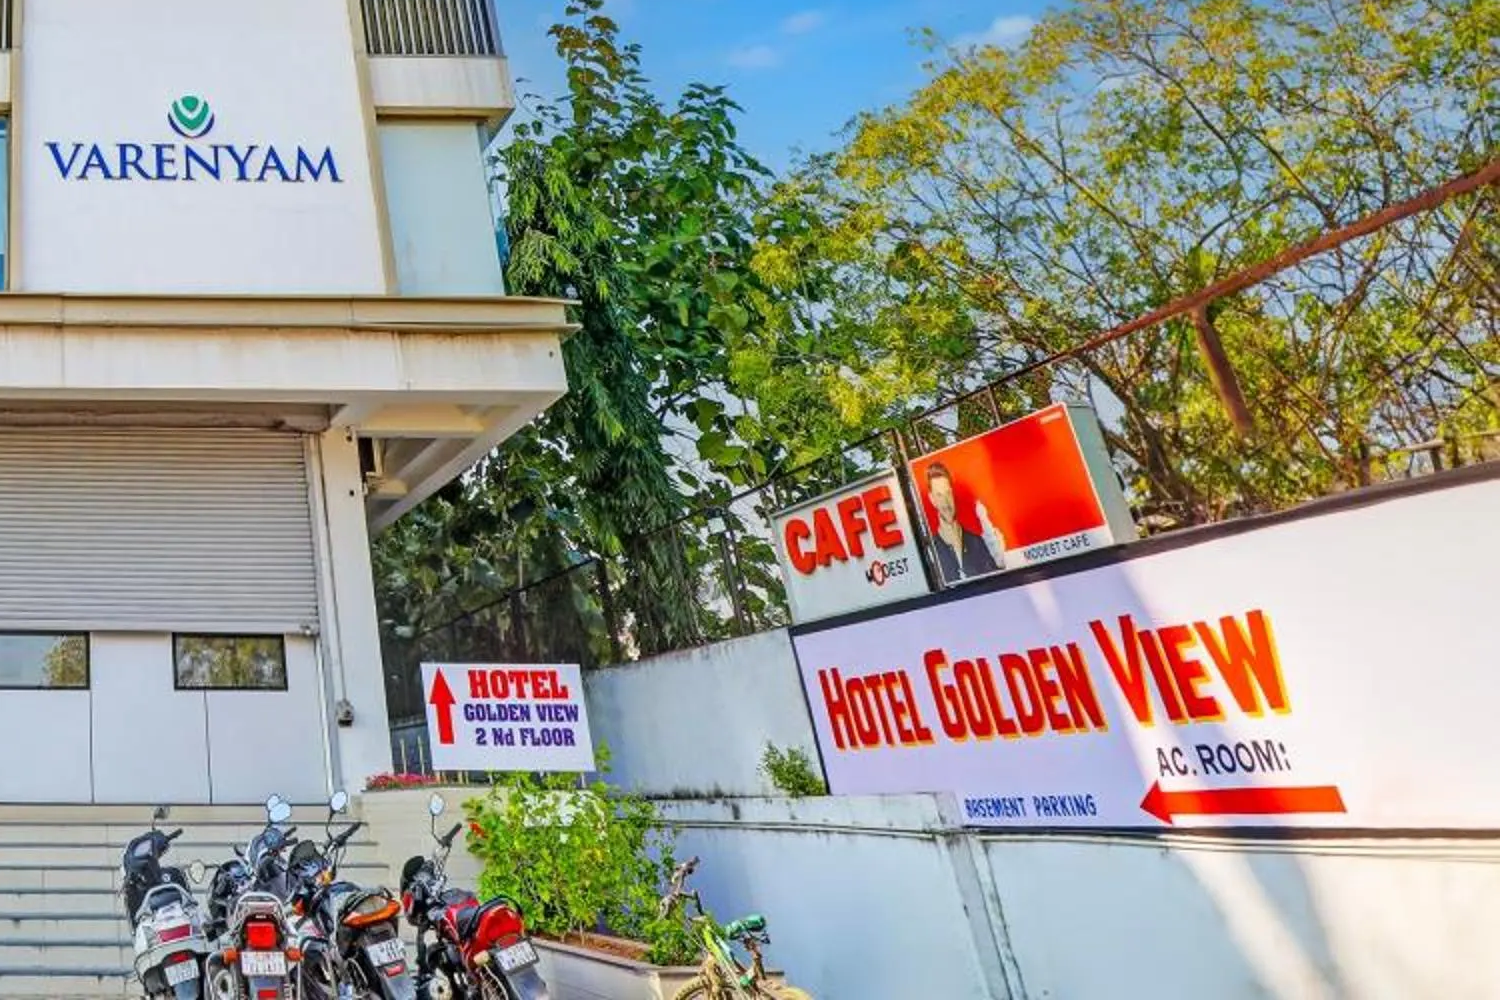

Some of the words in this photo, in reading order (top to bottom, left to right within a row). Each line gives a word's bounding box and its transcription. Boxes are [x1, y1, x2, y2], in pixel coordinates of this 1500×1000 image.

[45, 141, 344, 183] VARENYAM
[785, 485, 904, 576] CAFE
[1023, 541, 1061, 560] MODEST
[1062, 532, 1091, 551] CAFE
[467, 669, 569, 699] HOTEL
[818, 667, 935, 750] HOTEL
[923, 641, 1109, 743] GOLDEN
[1088, 609, 1292, 729] VIEW
[464, 703, 531, 723] GOLDEN
[535, 703, 579, 723] VIEW
[475, 727, 487, 745] 2
[492, 727, 515, 746] Nd
[518, 727, 576, 747] FLOOR
[964, 797, 1027, 818] BASEMENT
[1032, 794, 1098, 817] PARKING
